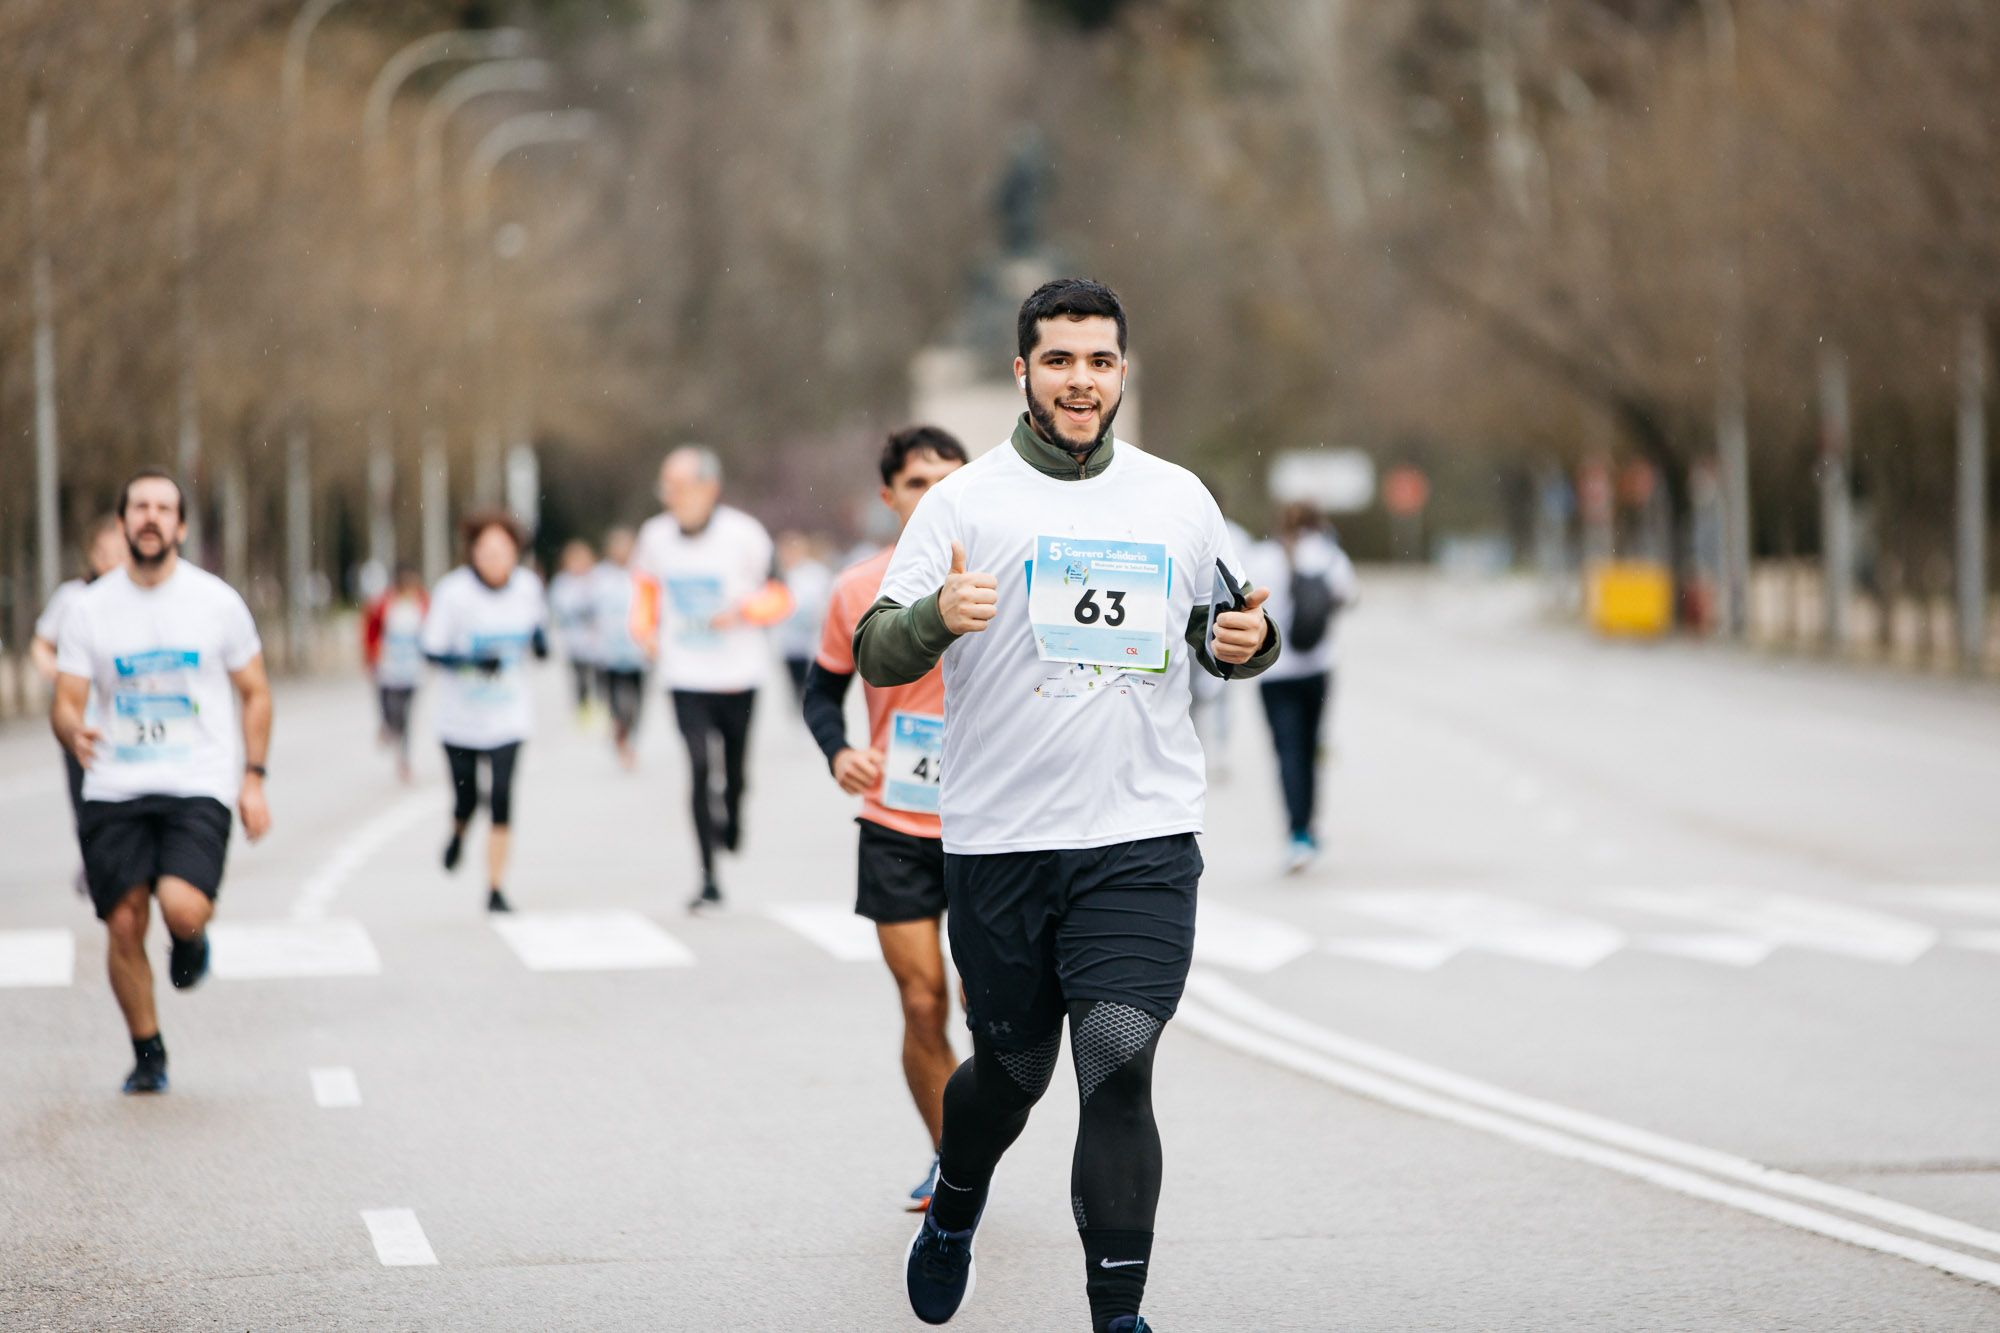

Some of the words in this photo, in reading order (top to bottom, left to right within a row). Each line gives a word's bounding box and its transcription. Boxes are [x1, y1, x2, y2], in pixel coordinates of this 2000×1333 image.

[1064, 547, 1103, 558] Carrera
[1106, 549, 1147, 561] Solidaria
[1074, 589, 1126, 626] 63
[1126, 647, 1138, 655] CSL
